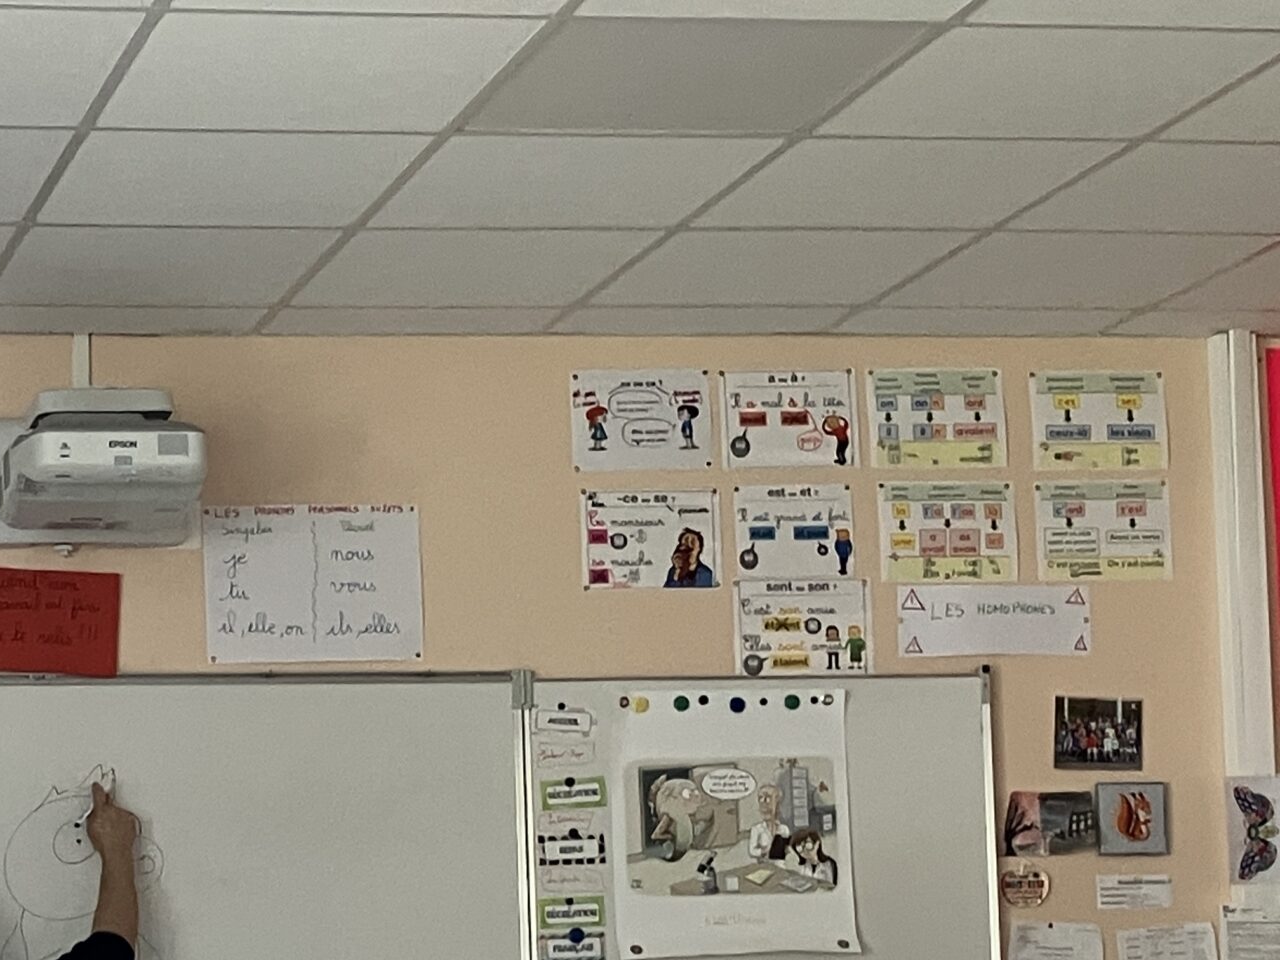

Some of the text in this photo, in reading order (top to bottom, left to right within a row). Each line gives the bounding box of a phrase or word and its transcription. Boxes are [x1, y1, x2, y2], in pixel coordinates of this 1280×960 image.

[108, 439, 138, 449] EPSON
[214, 506, 241, 520] LES
[329, 548, 376, 563] nous
[223, 552, 249, 580] je
[218, 580, 251, 602] tu
[329, 581, 377, 595] vous
[766, 581, 793, 593] sont
[807, 582, 831, 593] son
[930, 600, 1056, 621] LES HOMOPHONES
